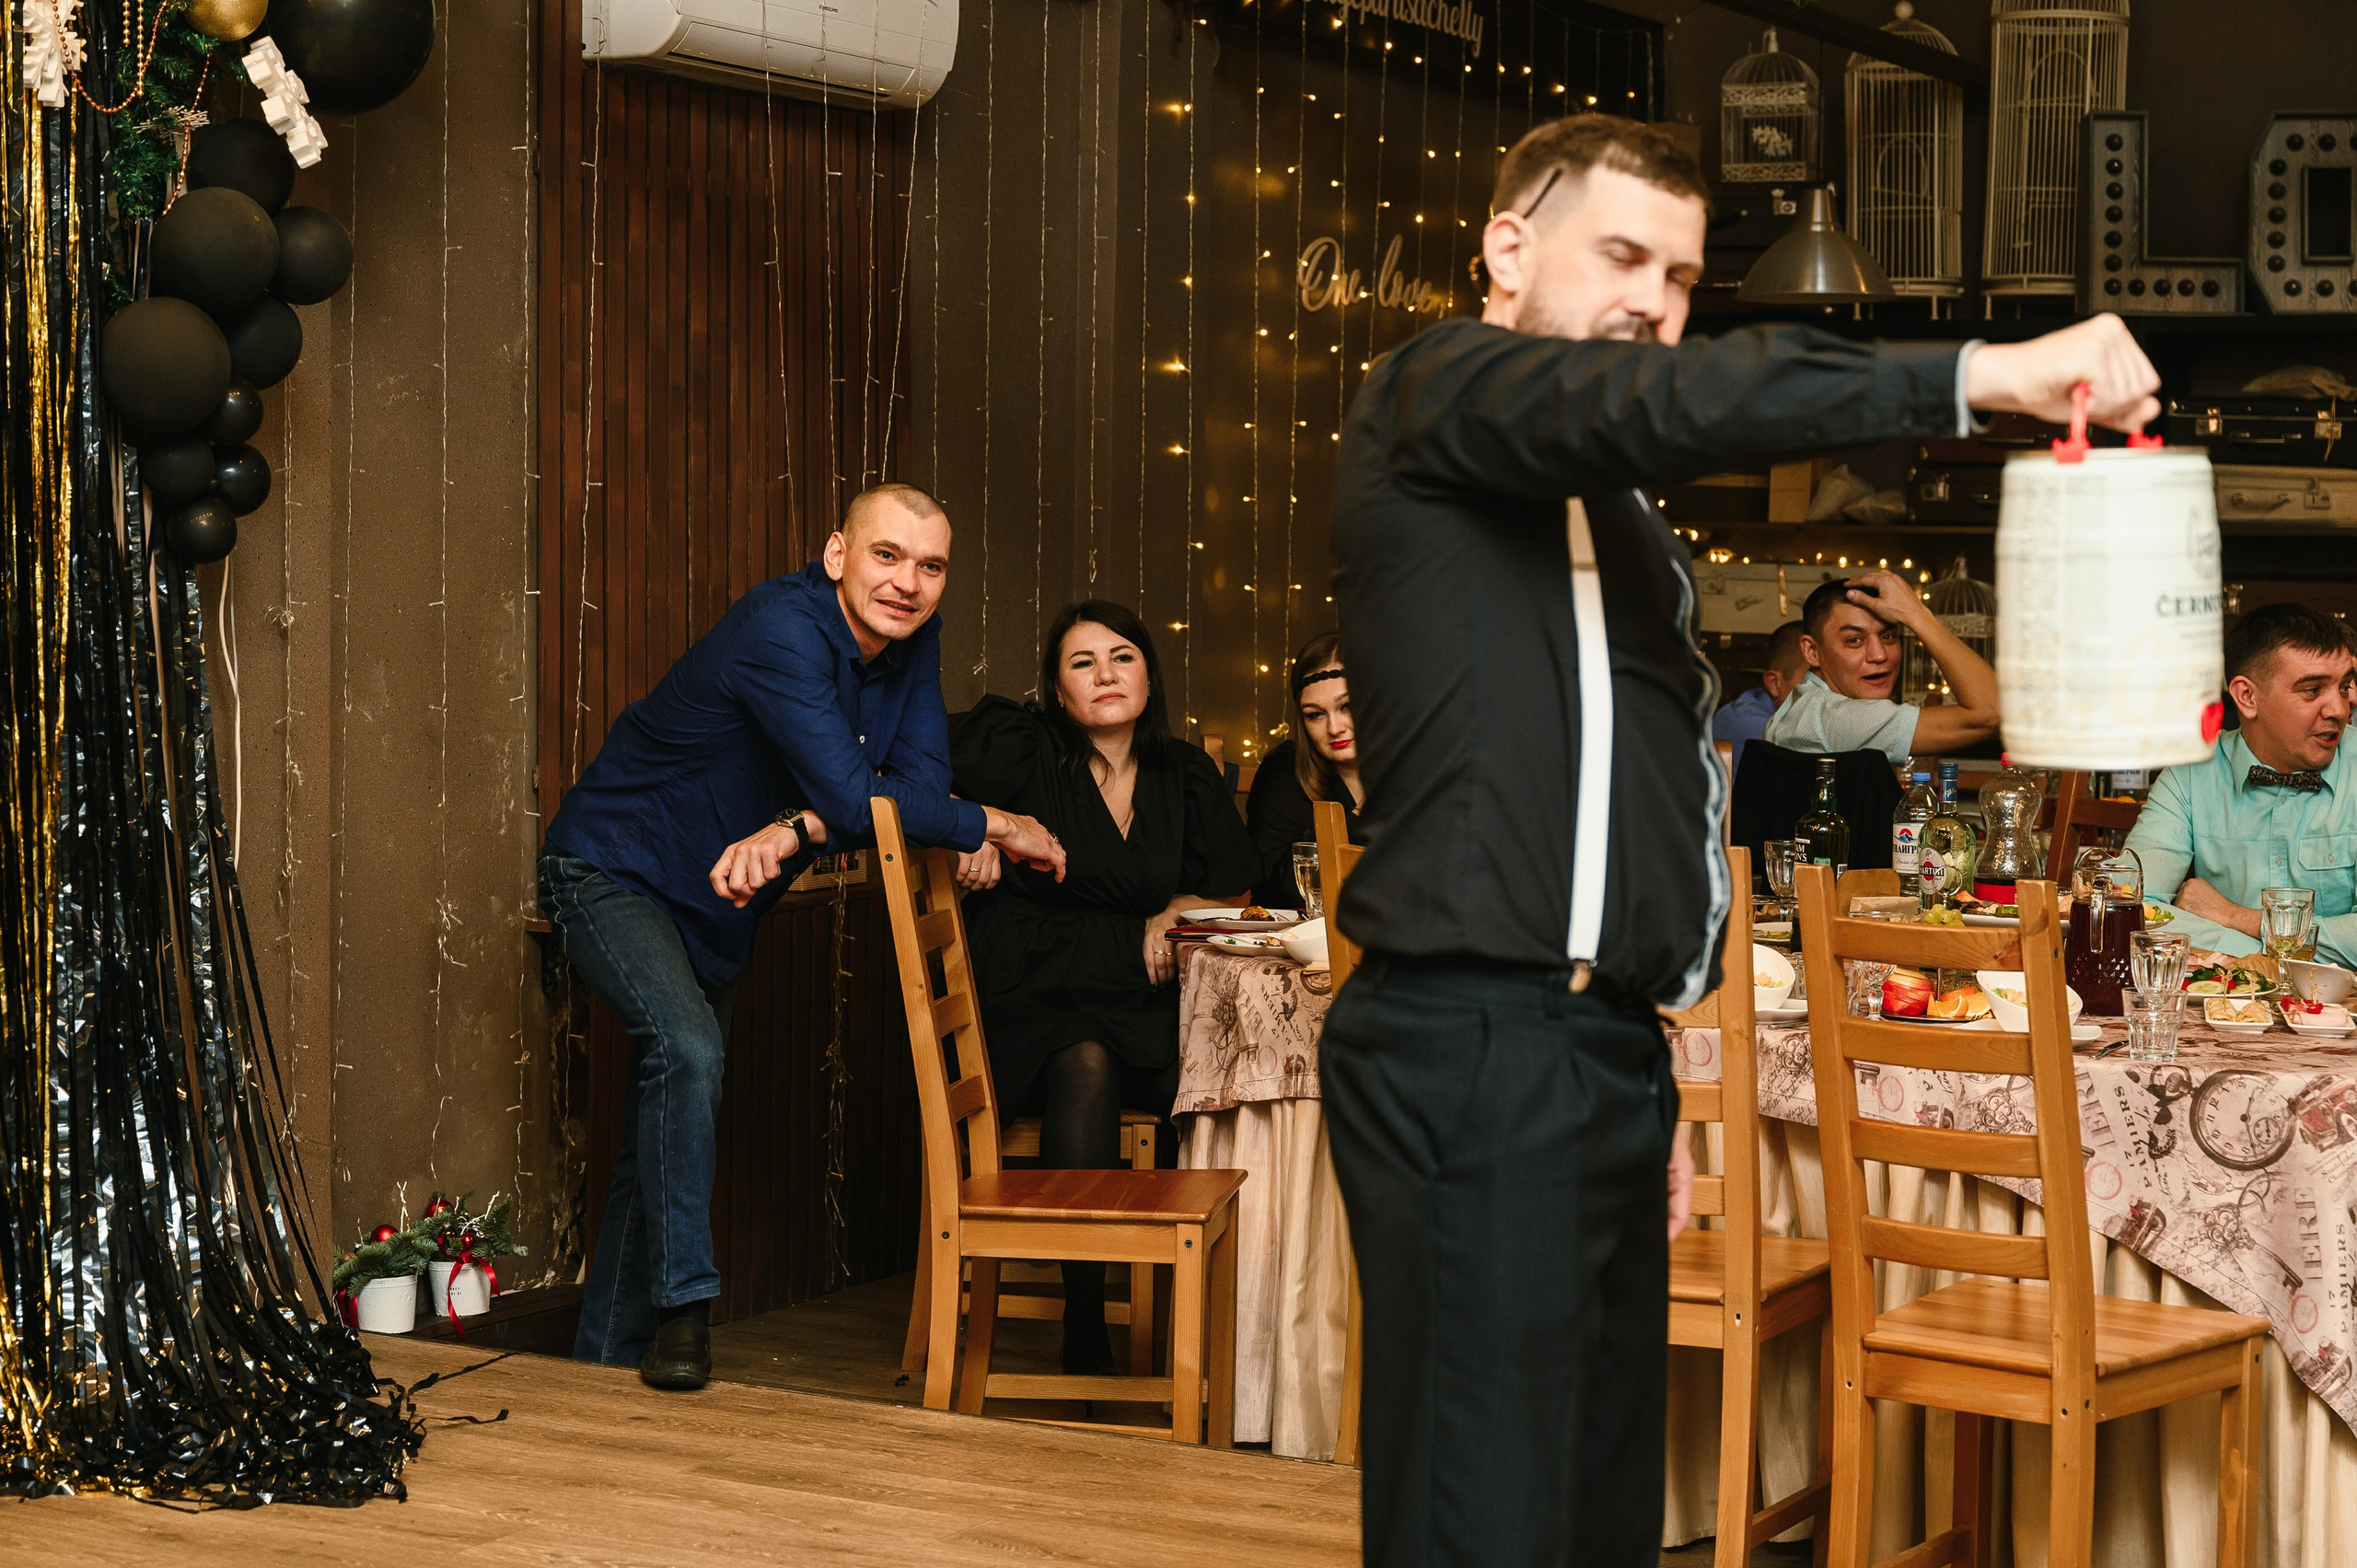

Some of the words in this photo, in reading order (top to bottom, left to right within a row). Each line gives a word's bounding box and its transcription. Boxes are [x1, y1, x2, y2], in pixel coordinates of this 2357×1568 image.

[1298, 237, 1366, 312] One
[2114, 1086, 2153, 1188] PAMIERS
[2335, 1223, 2349, 1333] PAMIERS
